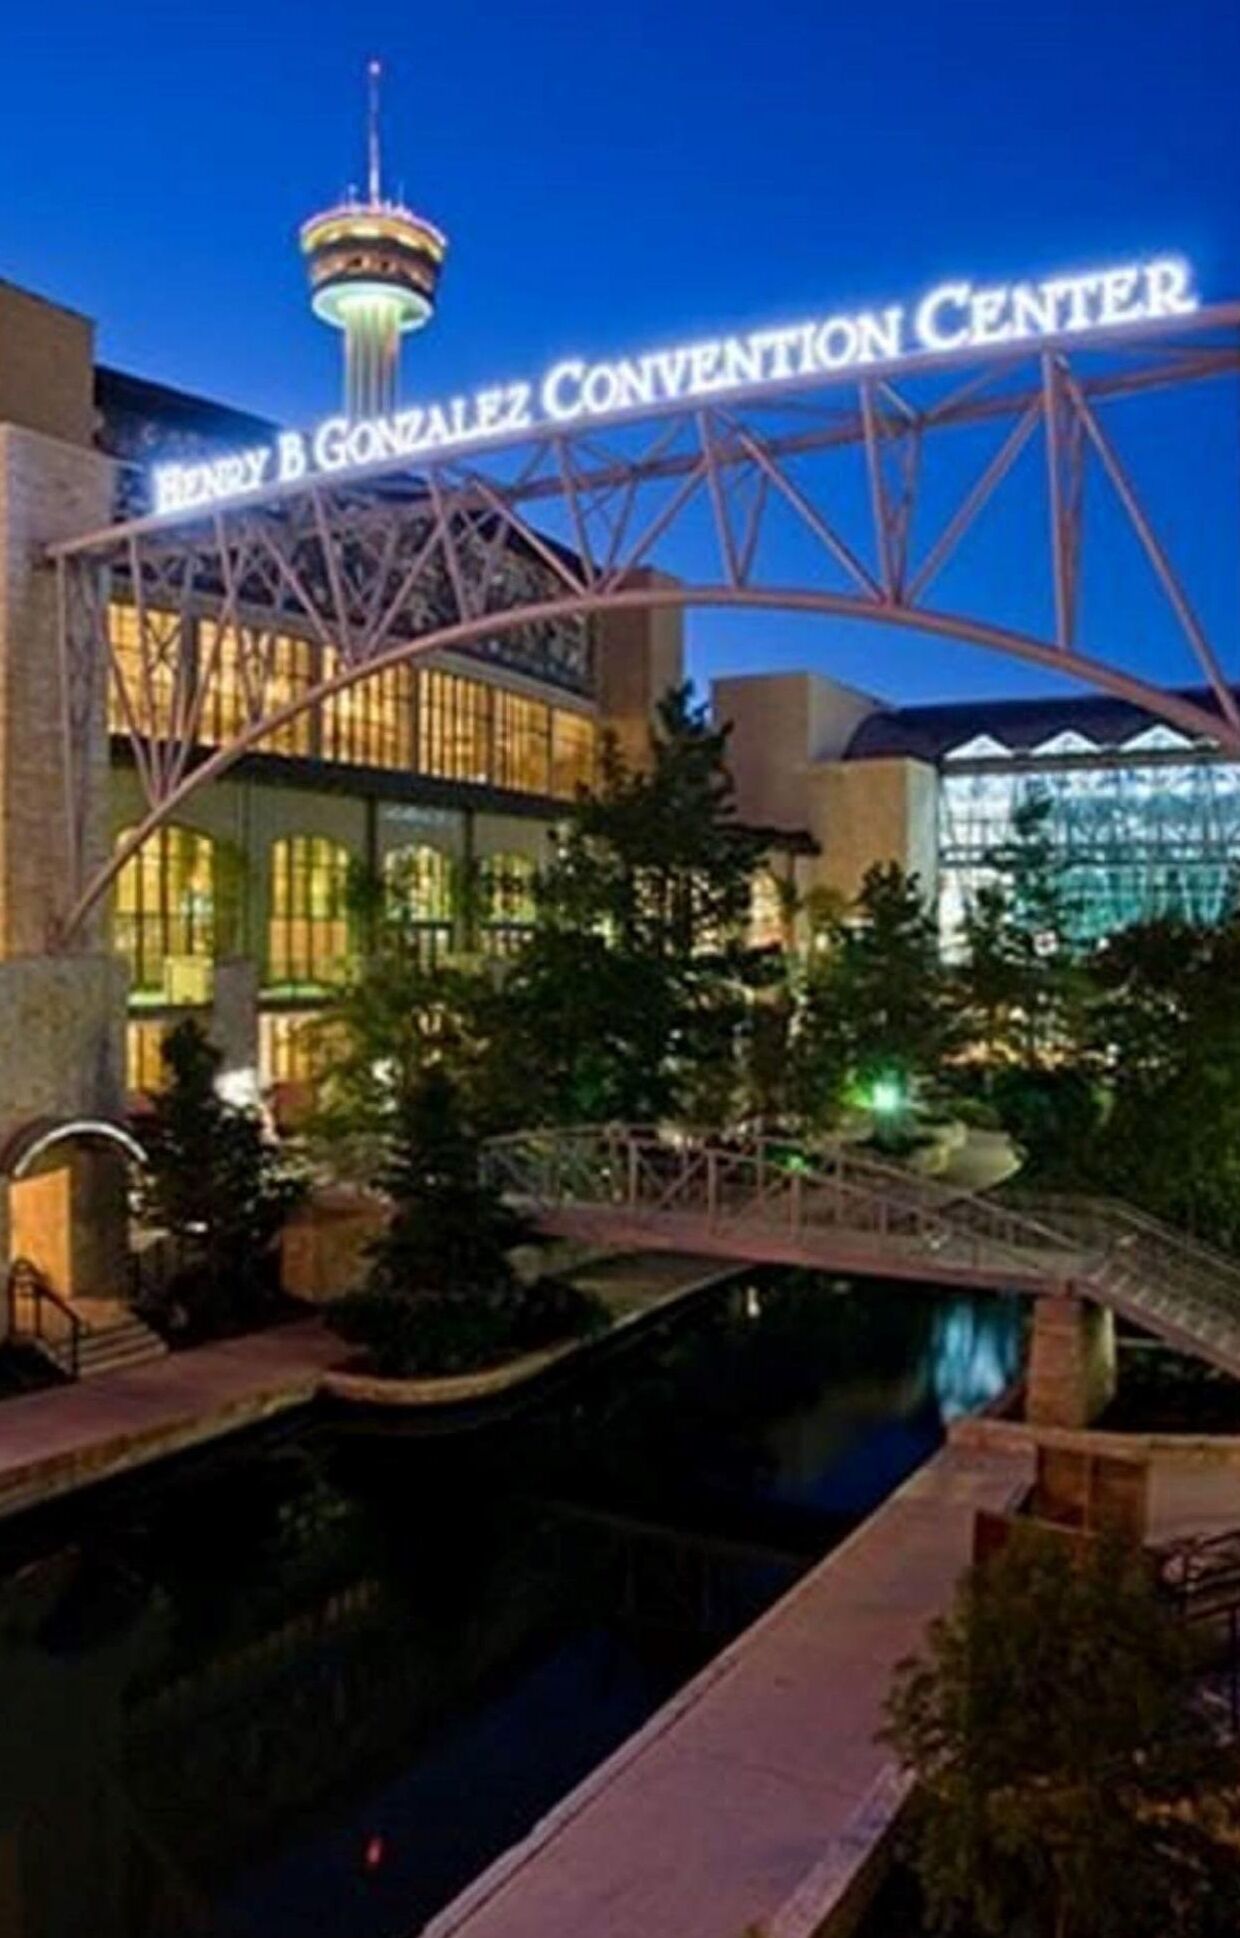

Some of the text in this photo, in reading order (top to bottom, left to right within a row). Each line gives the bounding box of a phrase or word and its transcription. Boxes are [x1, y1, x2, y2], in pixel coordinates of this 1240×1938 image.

[153, 258, 1198, 515] HENRY B GONZALEZ CONVENTION CENTER
